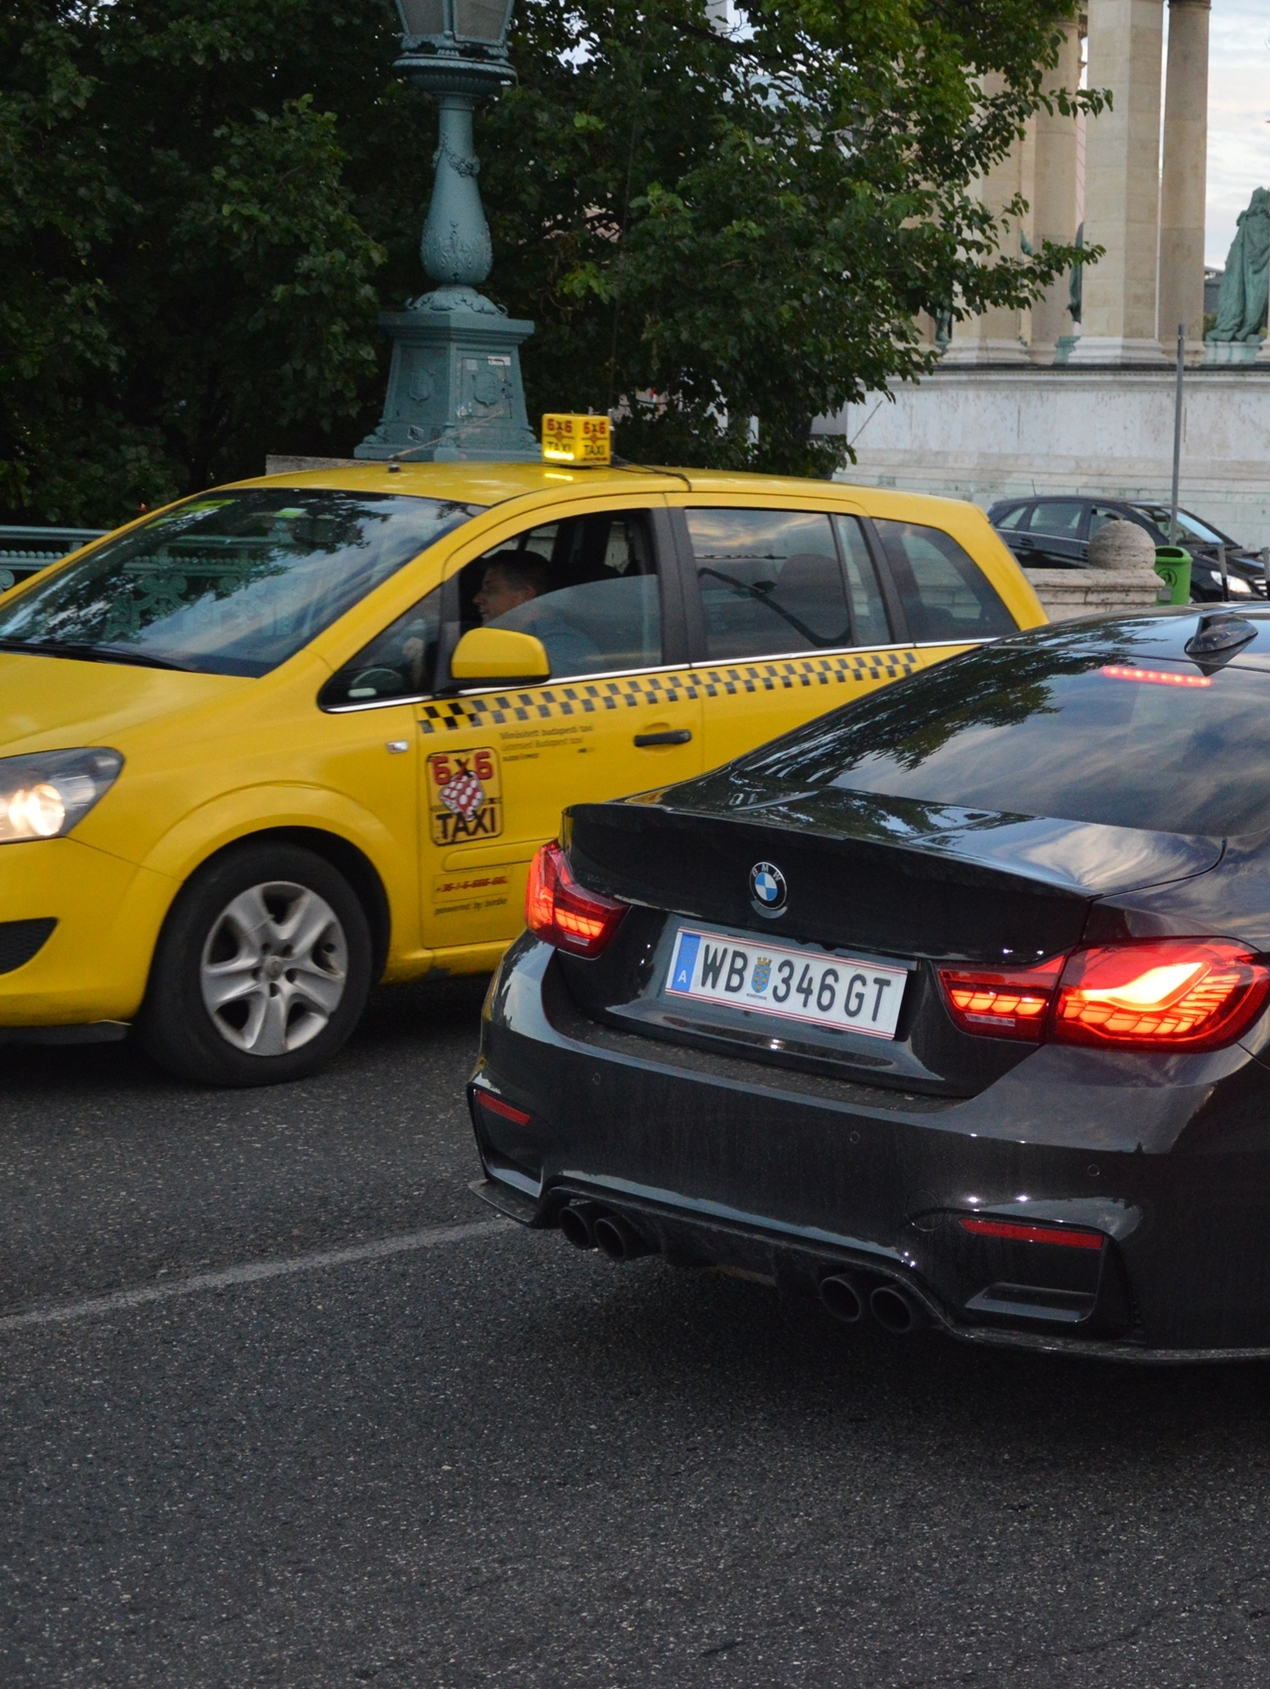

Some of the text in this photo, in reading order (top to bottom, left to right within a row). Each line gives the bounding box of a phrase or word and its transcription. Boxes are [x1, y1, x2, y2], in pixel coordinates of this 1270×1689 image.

[584, 444, 605, 456] TAXI
[436, 807, 496, 842] TAXI
[752, 864, 782, 881] BMW
[677, 970, 687, 984] A
[701, 944, 748, 993] WB
